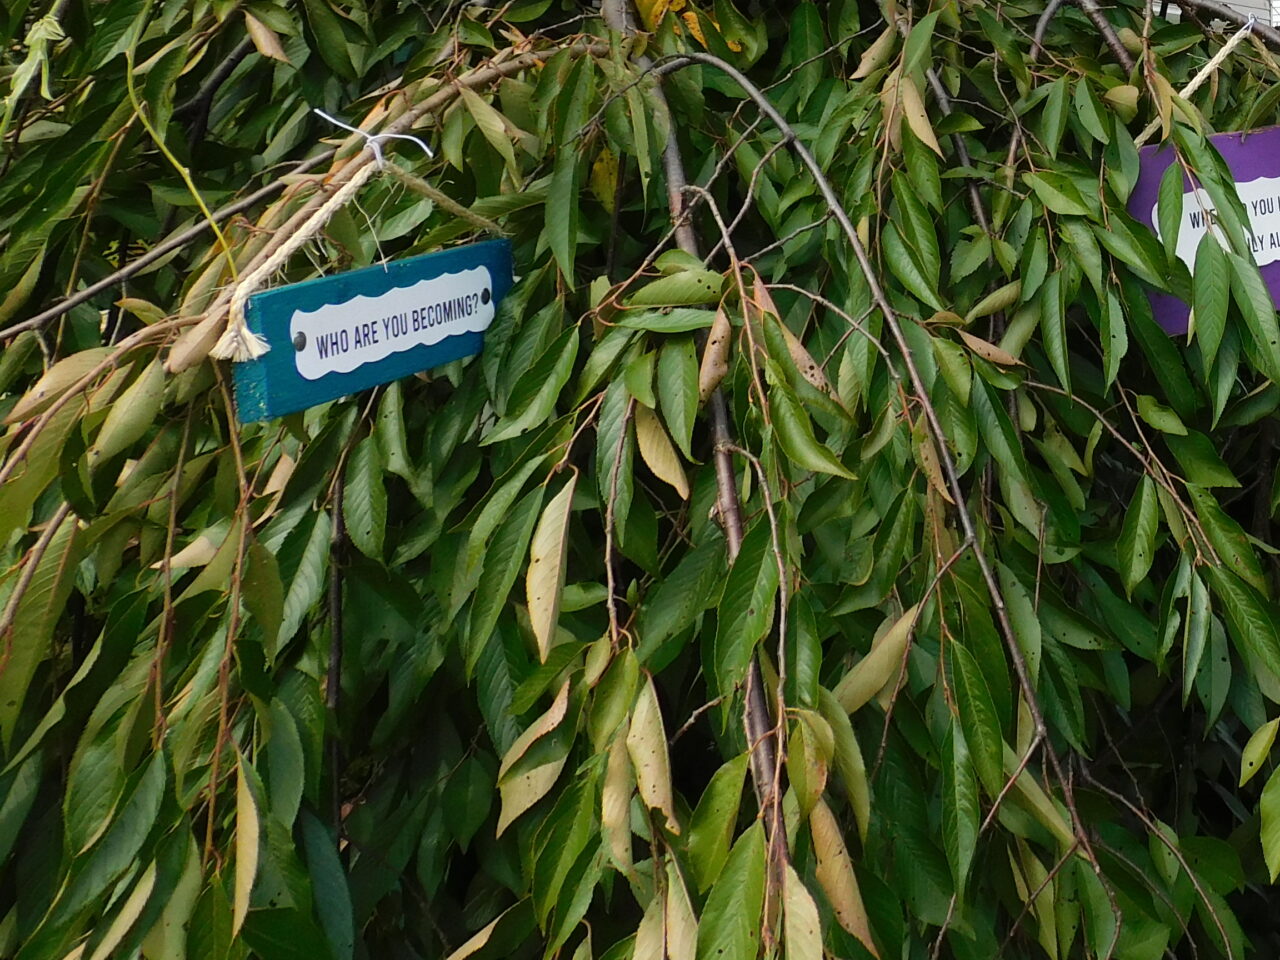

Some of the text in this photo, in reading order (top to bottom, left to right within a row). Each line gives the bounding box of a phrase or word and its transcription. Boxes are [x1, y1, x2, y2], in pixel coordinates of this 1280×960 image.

[1251, 197, 1274, 217] YOU
[316, 292, 479, 360] WHO ARE YOU BECOMING?
